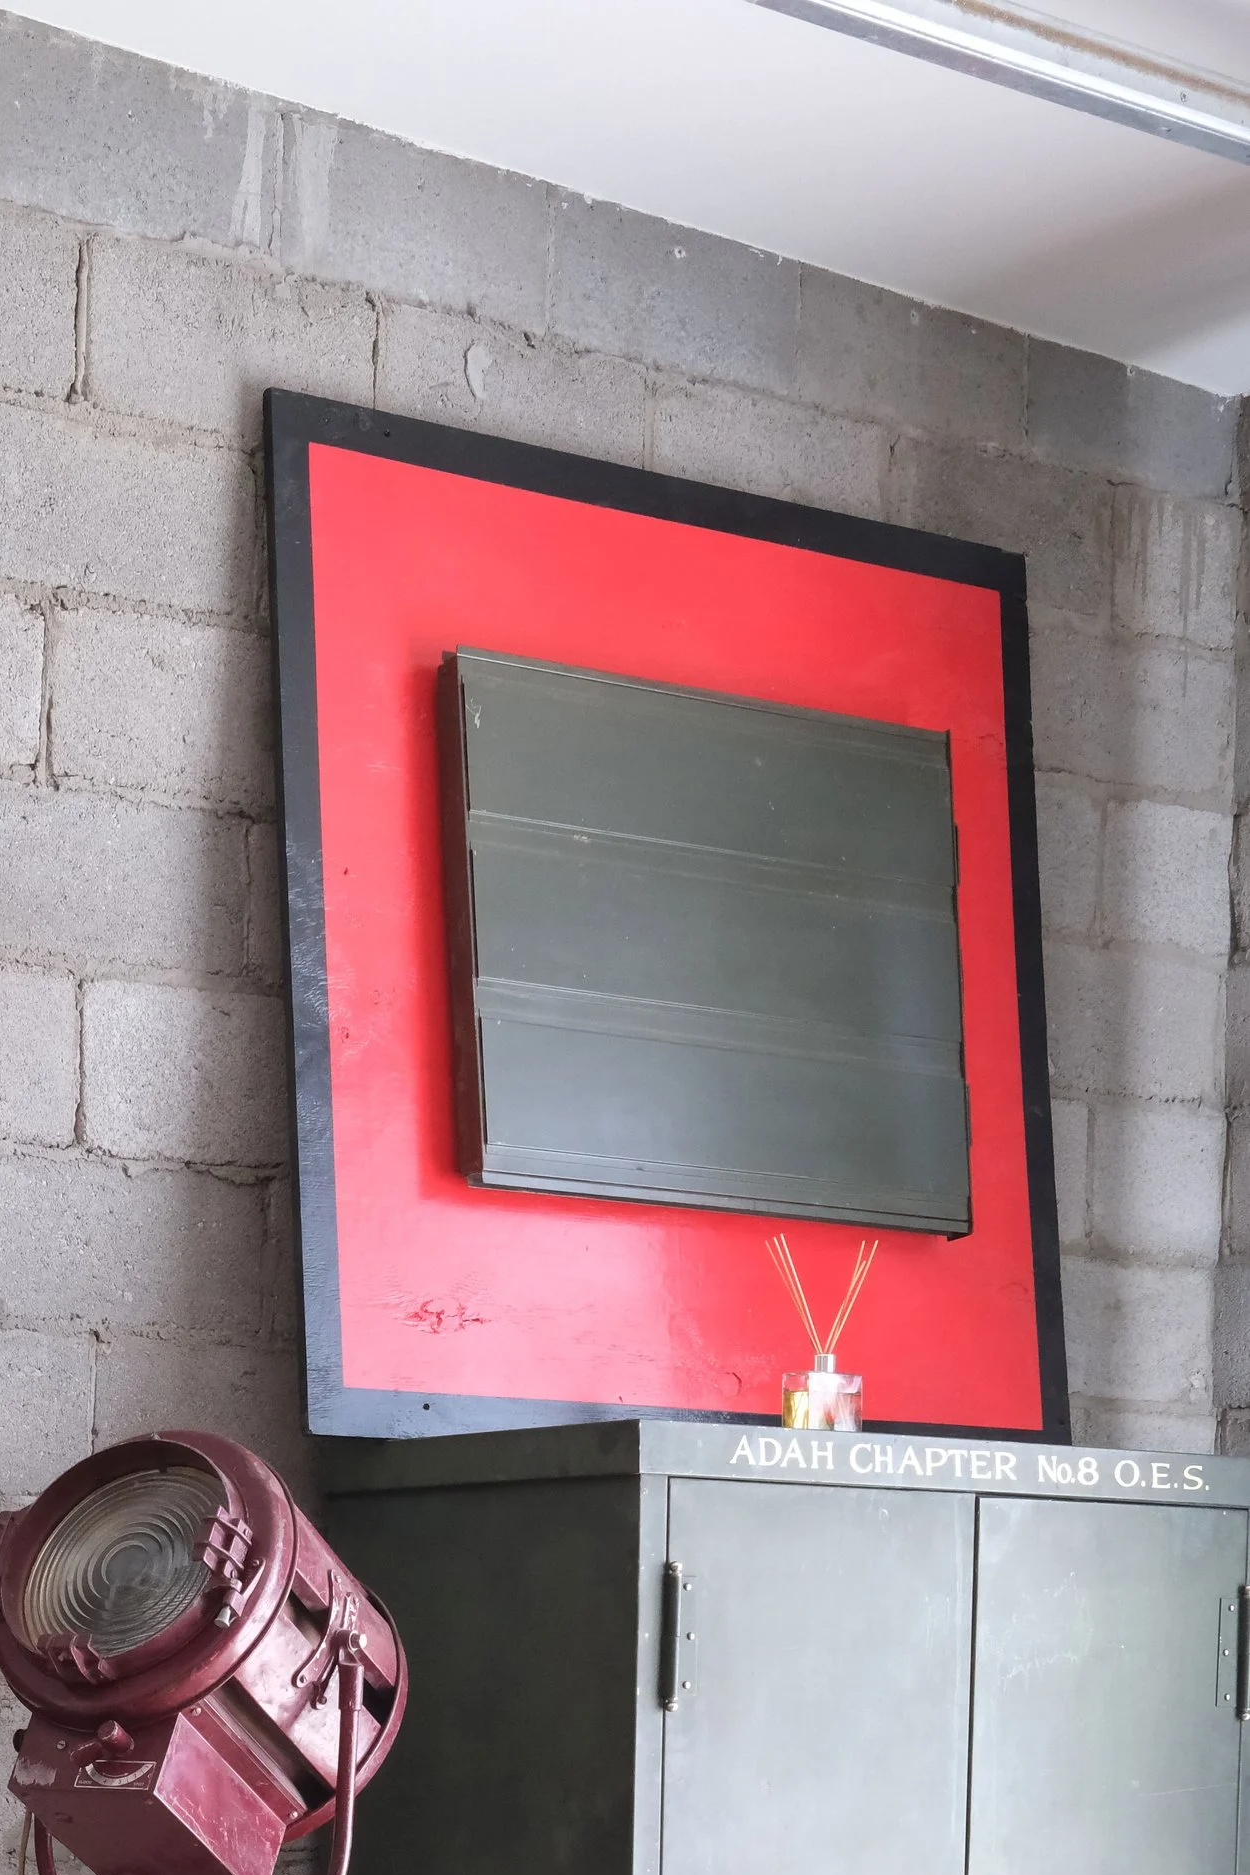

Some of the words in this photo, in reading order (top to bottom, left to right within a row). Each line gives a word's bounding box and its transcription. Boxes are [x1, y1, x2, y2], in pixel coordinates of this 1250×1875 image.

[729, 1434, 834, 1470] ADAH
[849, 1442, 1018, 1481] CHAPTER
[1114, 1459, 1210, 1491] O.E.S.
